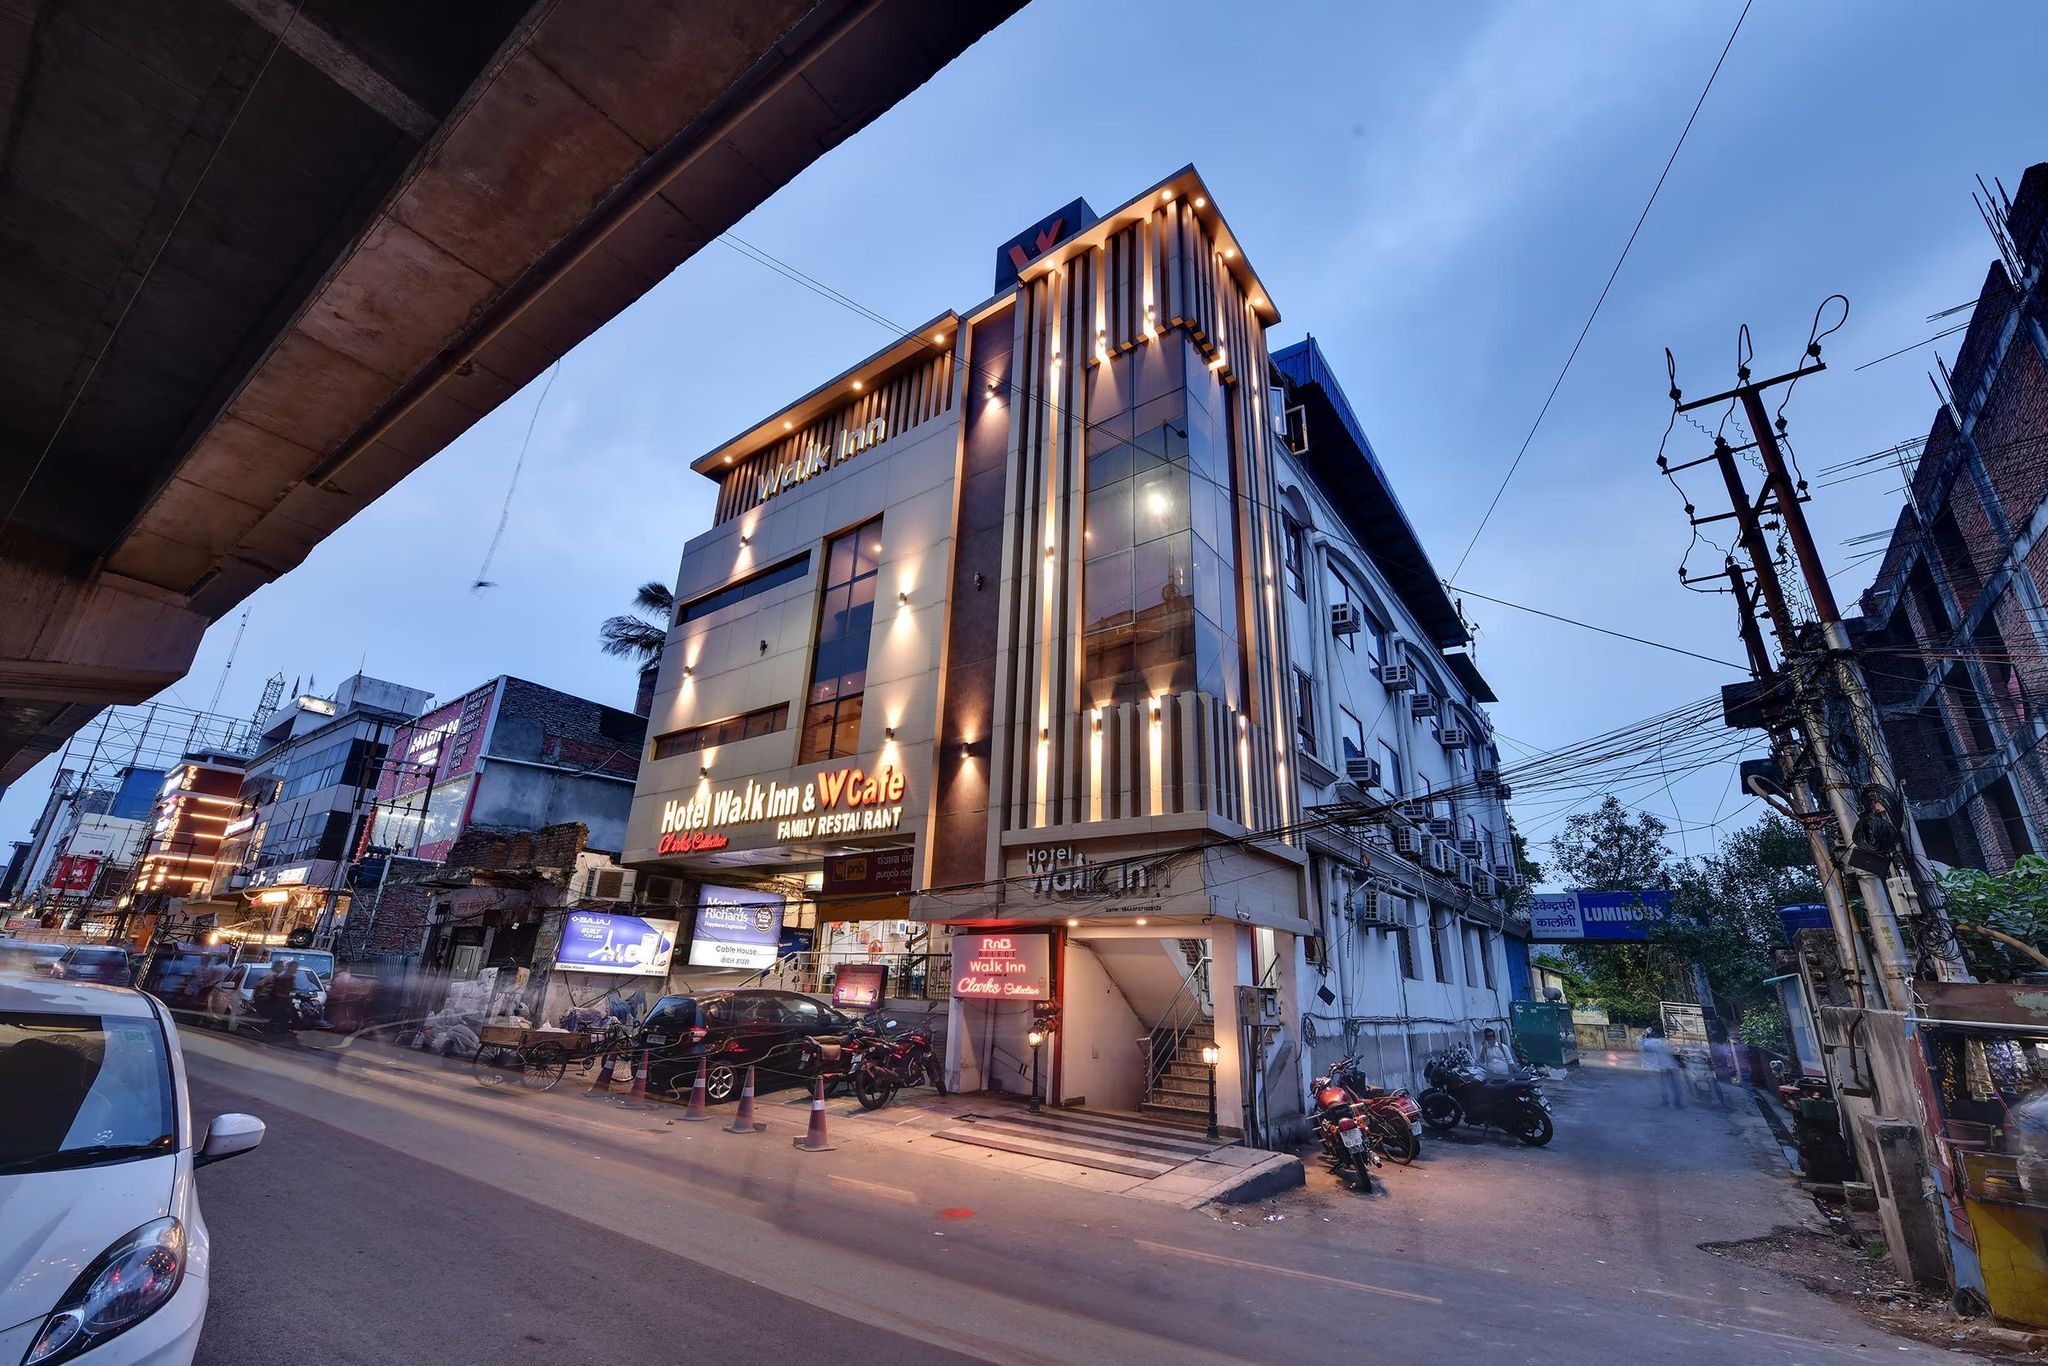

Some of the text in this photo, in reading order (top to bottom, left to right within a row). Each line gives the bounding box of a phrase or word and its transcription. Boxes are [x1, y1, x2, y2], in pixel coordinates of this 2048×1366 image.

[757, 417, 887, 503] Walk Inn
[660, 792, 713, 834] Hotel
[713, 778, 767, 826] Walk
[767, 781, 800, 819] Inn
[801, 783, 816, 814] &
[777, 806, 903, 840] FAMILY RESTAURANT
[1026, 844, 1072, 863] Hotel
[847, 862, 864, 874] pnb
[875, 867, 899, 881] punjab
[1026, 852, 1171, 894] Walk Inn
[579, 916, 611, 926] BAJAJ
[704, 908, 749, 922] Richards
[1535, 914, 1576, 928] कालोनी
[715, 945, 757, 956] Cable House
[983, 938, 1012, 949] RnB
[978, 950, 1016, 958] SELECT
[969, 959, 1026, 973] Walk Inn
[957, 977, 1040, 995] Clarks Collection
